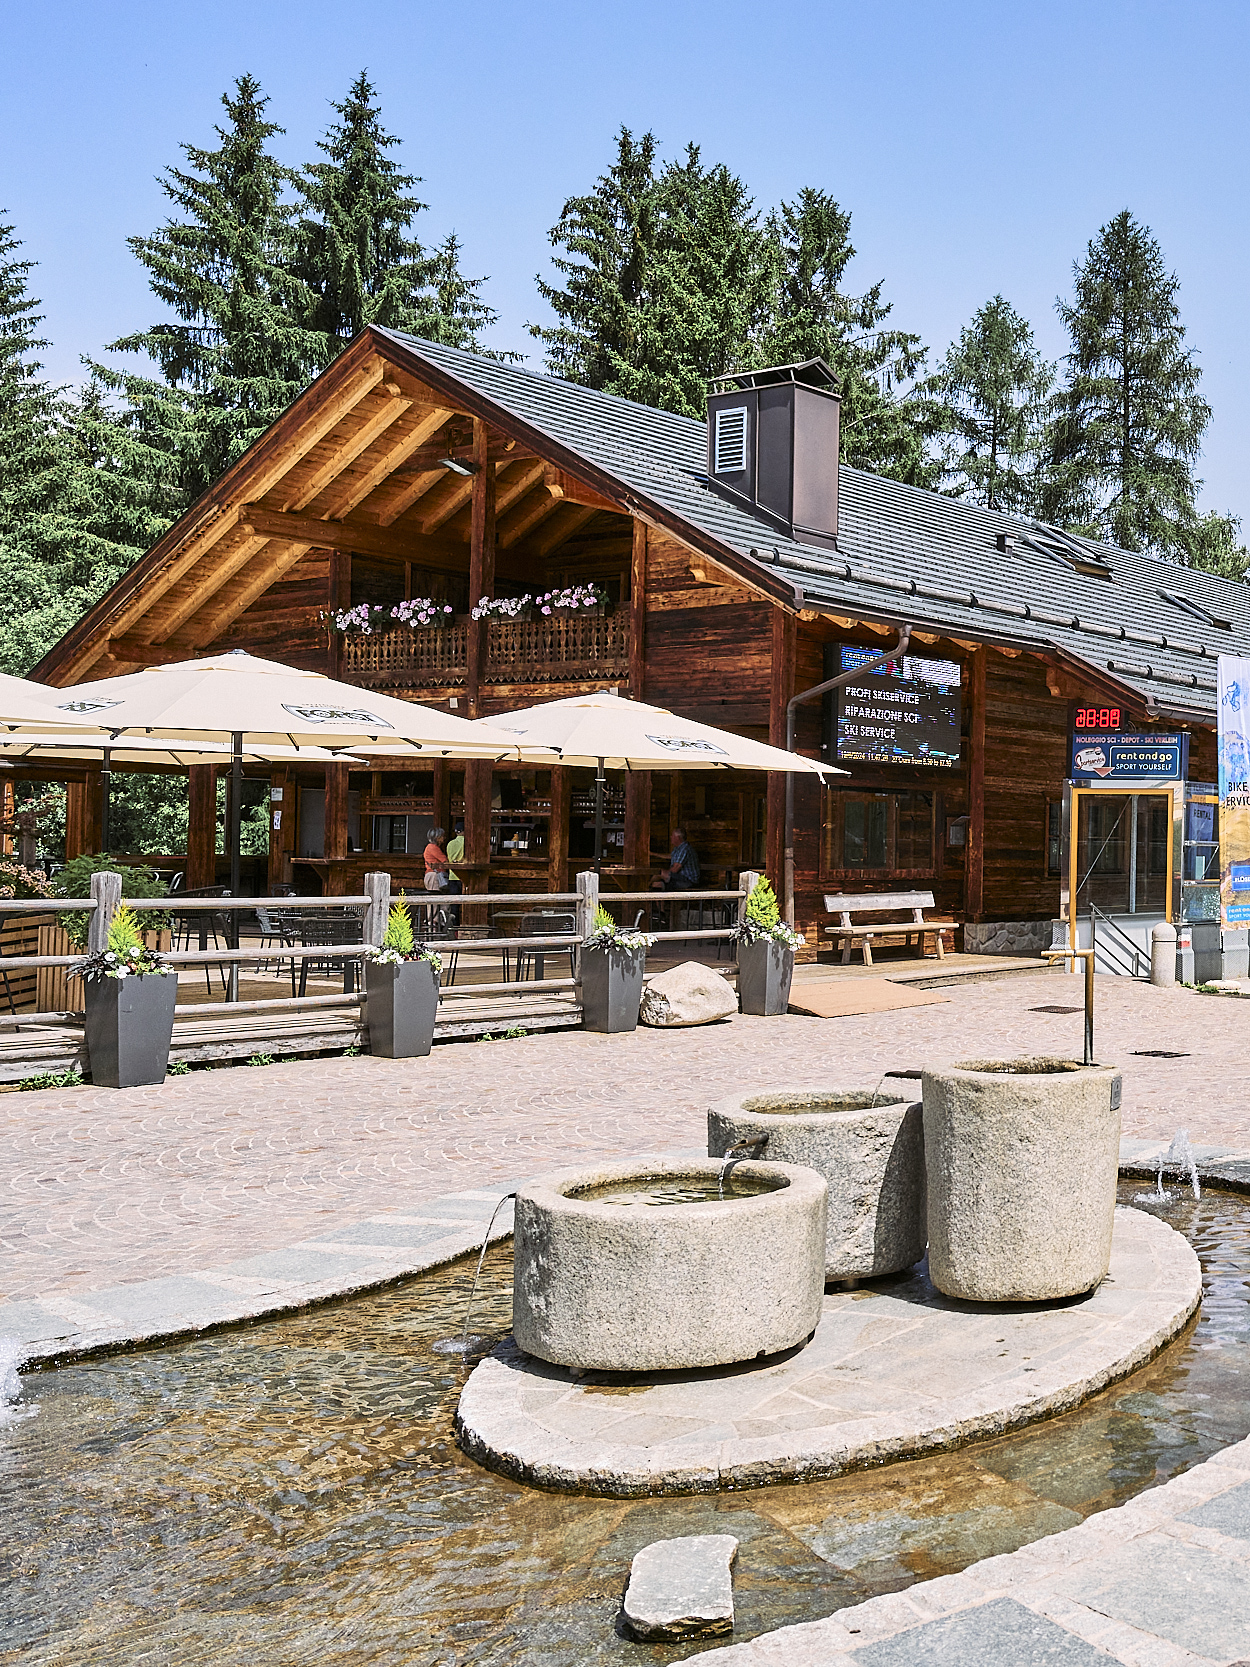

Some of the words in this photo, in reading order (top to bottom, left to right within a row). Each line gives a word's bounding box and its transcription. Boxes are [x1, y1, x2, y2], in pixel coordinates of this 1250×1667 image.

[1076, 736, 1107, 744] NOLEGGIO
[1107, 736, 1117, 744] SCI
[1121, 736, 1140, 744] DEPOT
[1145, 736, 1154, 744] SKI
[1154, 736, 1178, 744] VERLEIH
[1116, 752, 1137, 760] rent
[1138, 752, 1158, 760] and
[1158, 753, 1173, 763] go
[1138, 763, 1172, 771] YOURSELF
[1228, 781, 1248, 792] BIKE
[1226, 796, 1250, 807] ERVIC
